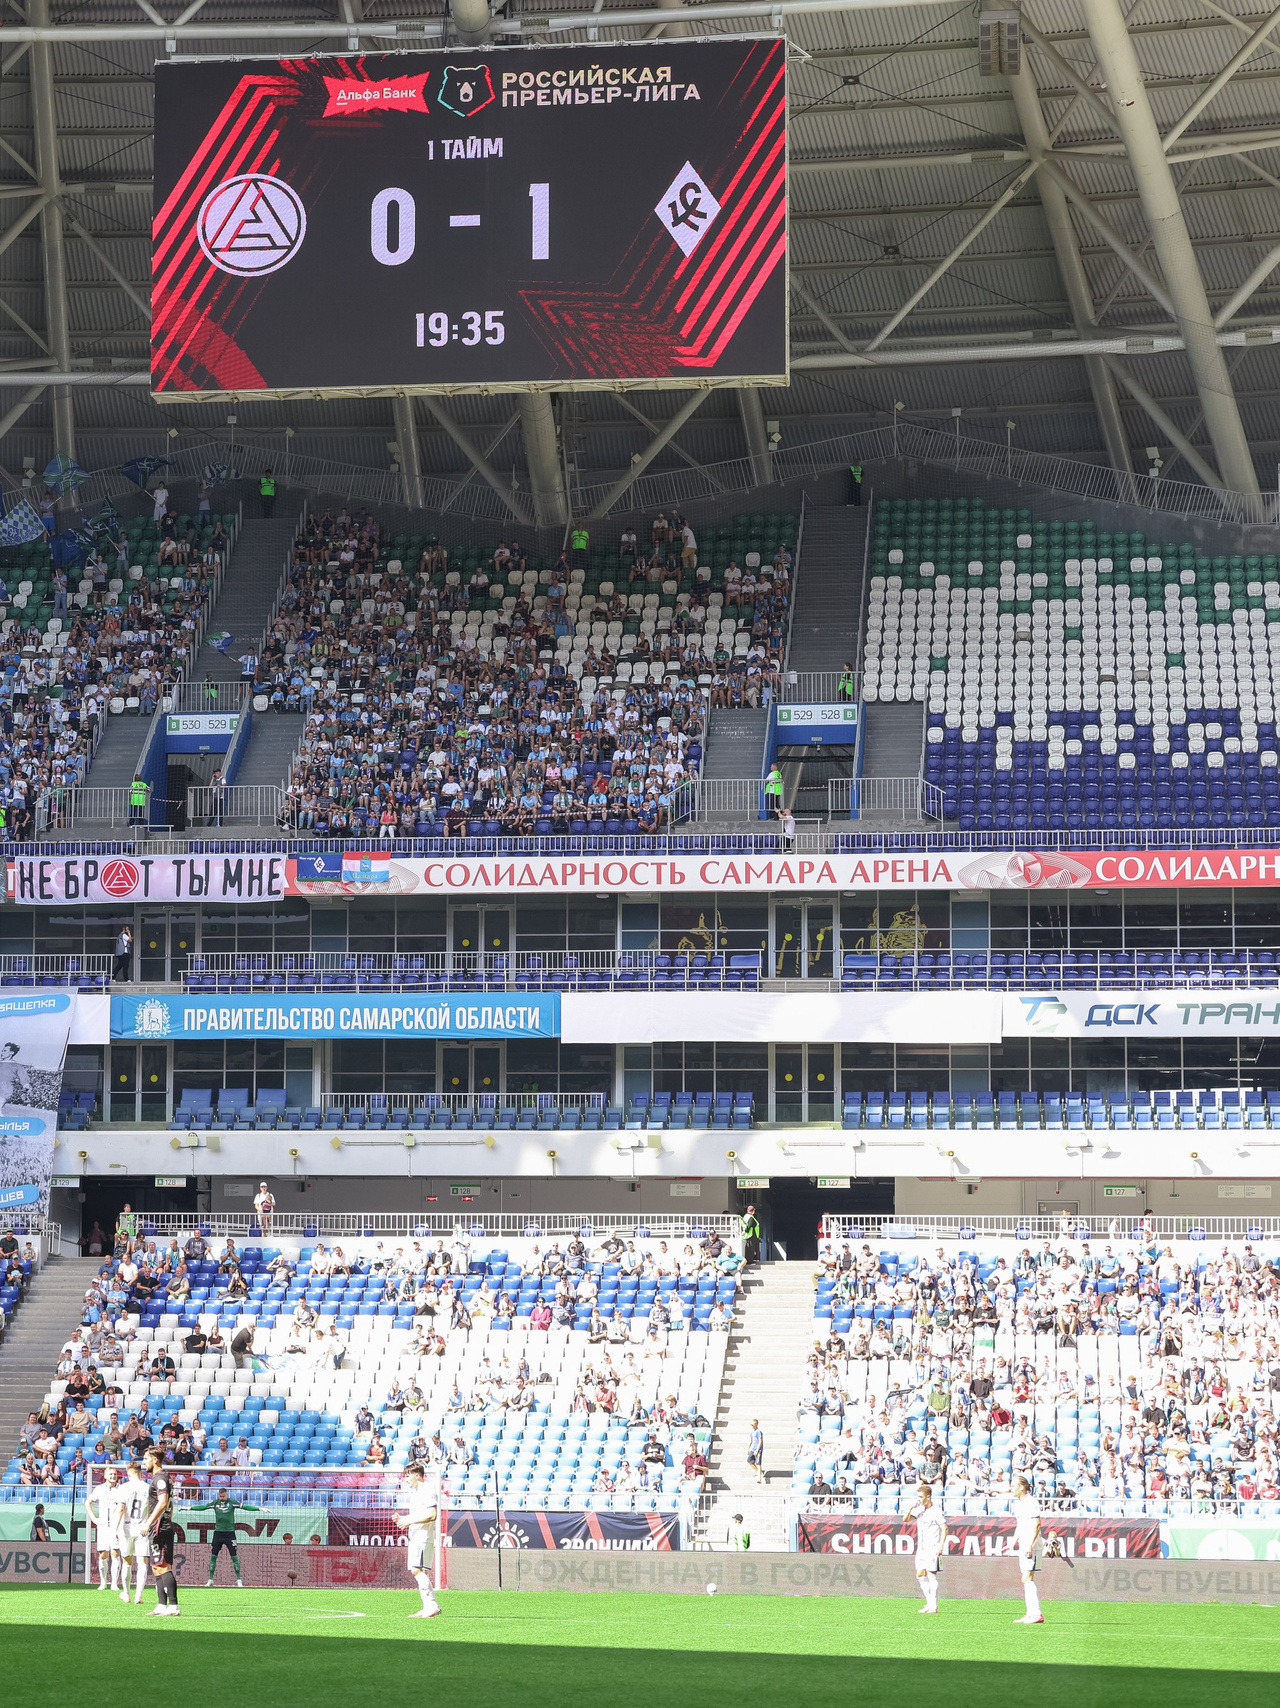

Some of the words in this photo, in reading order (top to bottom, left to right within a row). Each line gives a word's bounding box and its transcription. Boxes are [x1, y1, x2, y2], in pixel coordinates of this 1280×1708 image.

[502, 65, 672, 88] РОССИЙСКАЯ
[337, 87, 381, 105] Альфа
[382, 86, 417, 101] Банк
[502, 83, 701, 108] ПРЕМЬЕР-ЛИГА
[441, 136, 504, 160] ТАЙМ
[370, 187, 416, 266] 0
[529, 182, 550, 260] 1
[416, 310, 506, 347] 19:35
[182, 720, 201, 730] 530
[208, 719, 226, 729] 529
[793, 710, 813, 720] 529
[821, 709, 840, 720] 528
[19, 860, 53, 899] НЕ
[172, 859, 210, 898] ТЫ
[222, 858, 282, 897] МНЕ
[423, 861, 686, 887] СОЛИДАРНОСТЬ
[699, 860, 838, 885] САМАРА
[850, 858, 953, 884] АРЕНА
[183, 1006, 335, 1032] ПРАВИТЕЛЬСТВО
[339, 1002, 451, 1031] САМАРСКОЙ
[455, 1006, 540, 1030] ОБЛАСТИ
[1084, 1003, 1161, 1027] ДСК
[516, 1559, 723, 1588] РОЖДЕННАЯ
[741, 1563, 758, 1586] В
[770, 1562, 875, 1588] ГОРАХ
